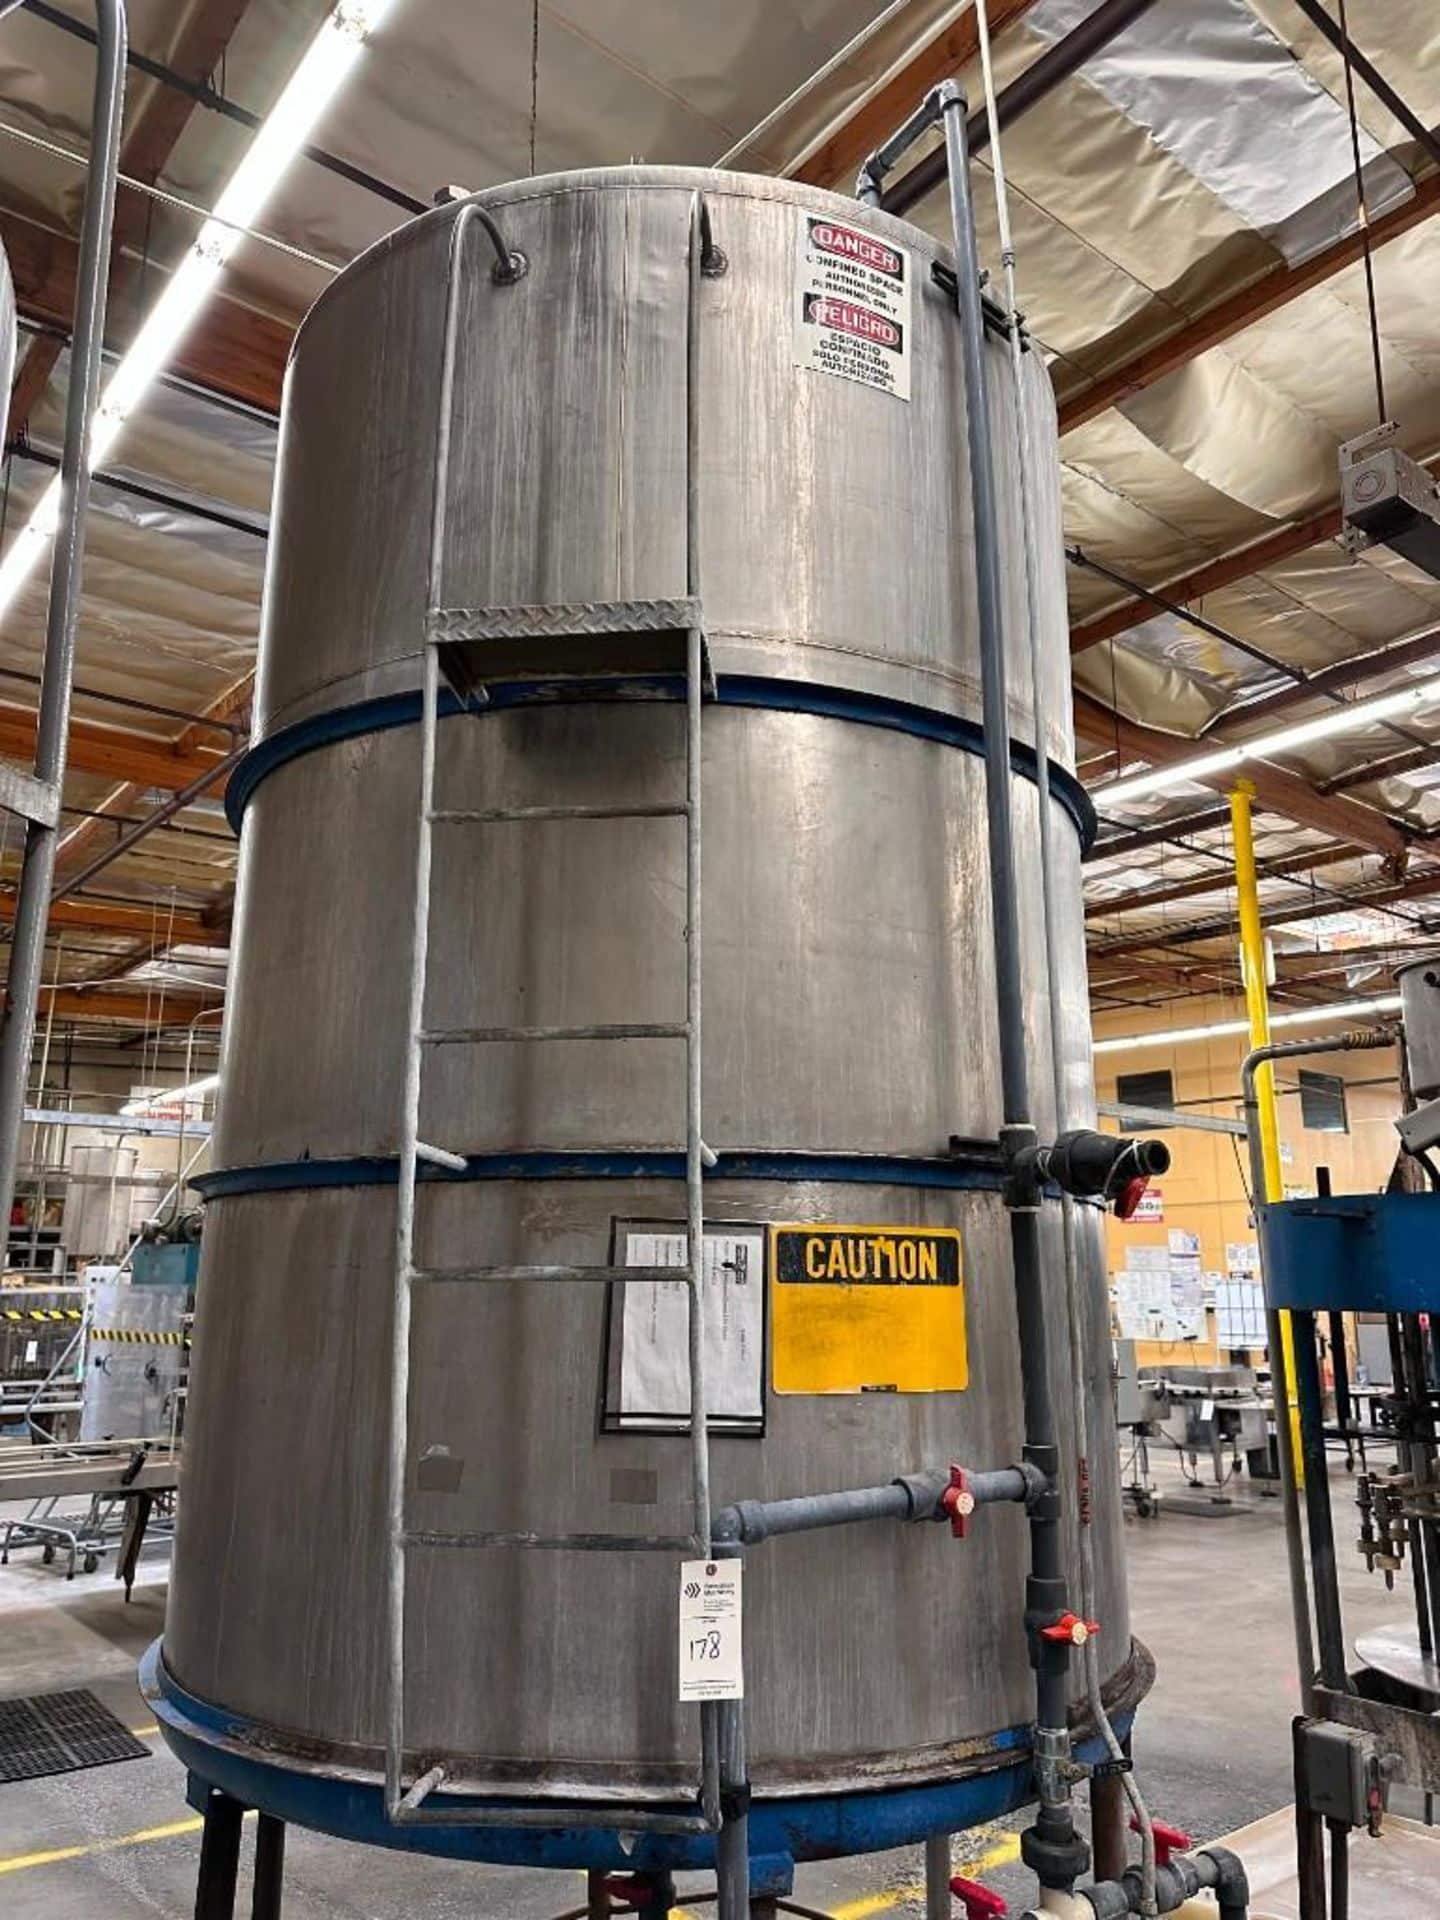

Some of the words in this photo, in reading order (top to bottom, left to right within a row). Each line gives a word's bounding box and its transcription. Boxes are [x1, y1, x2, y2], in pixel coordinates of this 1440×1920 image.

[819, 227, 895, 270] DANGER
[806, 254, 867, 278] CONFINED
[870, 273, 903, 296] SPACE
[812, 279, 872, 304] PERSONNEL
[873, 299, 897, 314] ONLY
[816, 303, 894, 343] PELIGRO
[820, 340, 889, 369] CONFINADO
[830, 333, 881, 356] ESPACIO
[812, 349, 841, 361] SOLO
[843, 357, 896, 383] PERSONAL
[806, 1237, 937, 1280] CAUTION
[690, 1630, 721, 1661] 178
